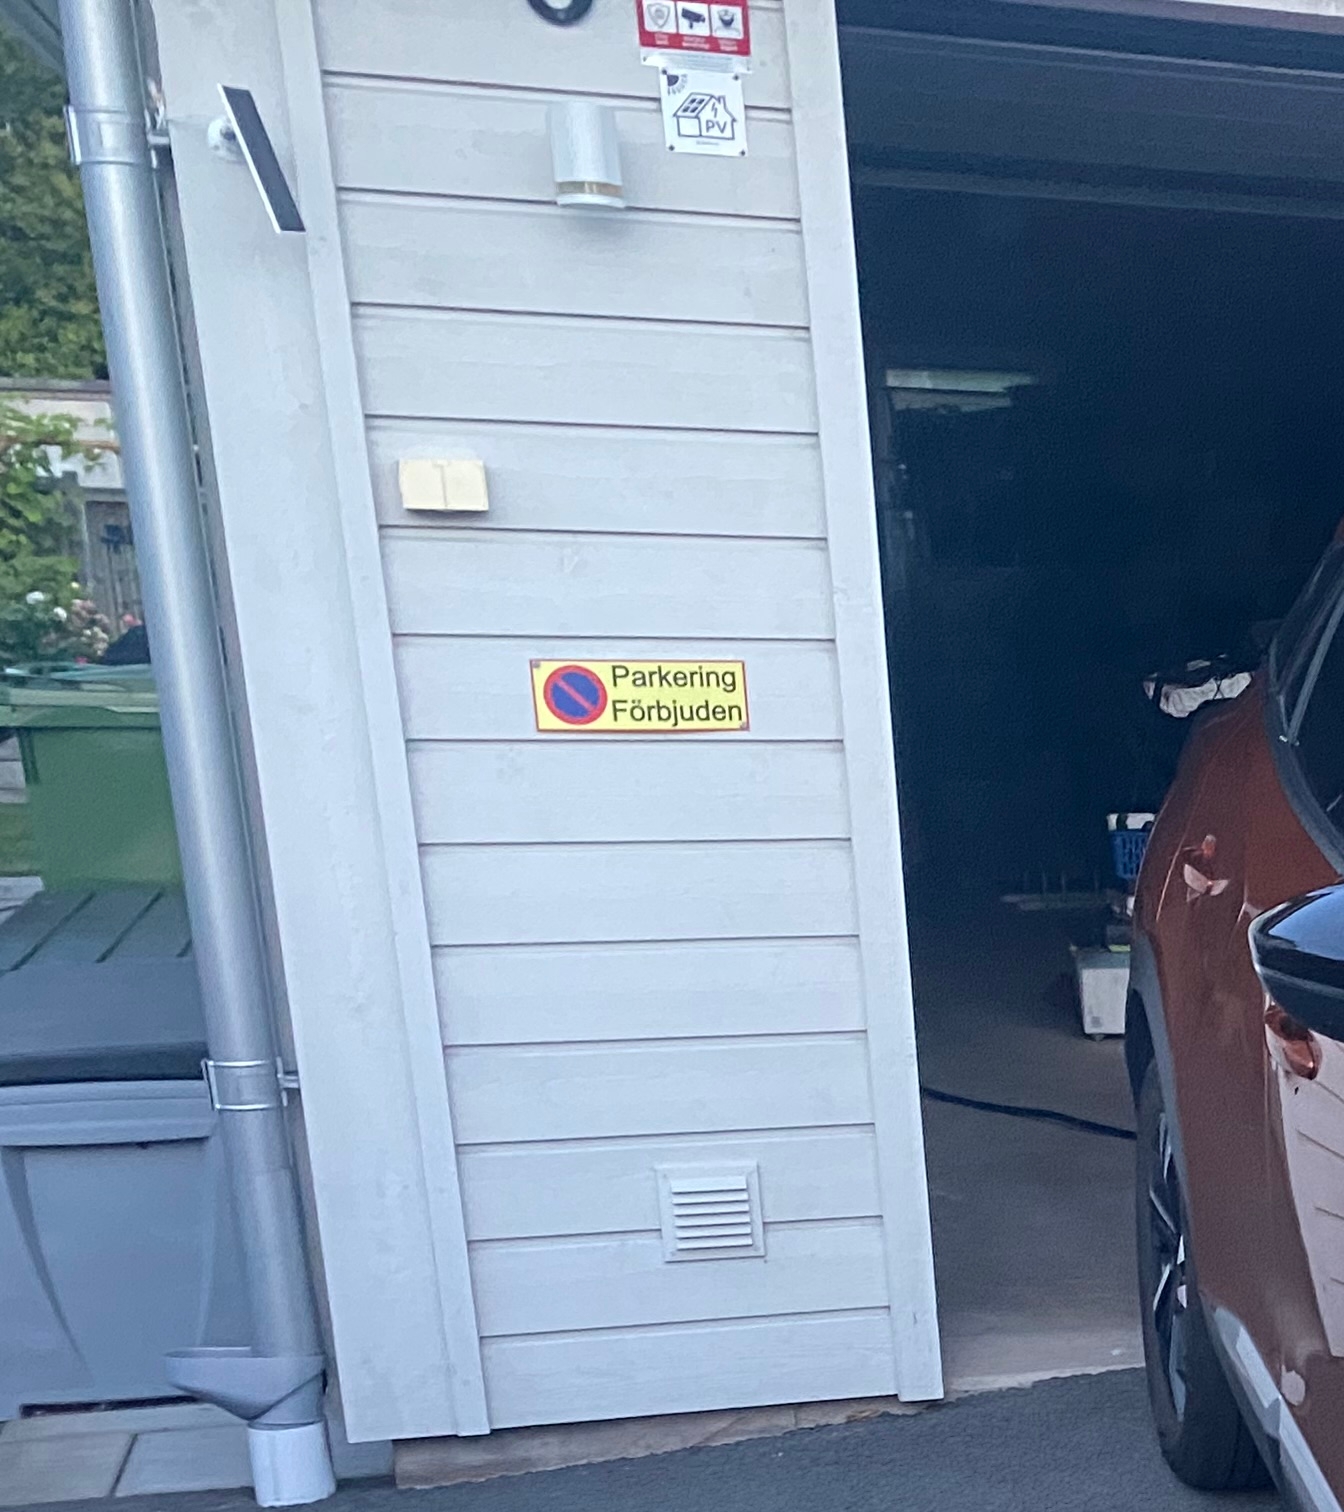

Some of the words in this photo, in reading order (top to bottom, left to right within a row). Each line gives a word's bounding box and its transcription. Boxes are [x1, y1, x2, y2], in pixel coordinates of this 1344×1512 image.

[705, 119, 728, 135] PV
[611, 665, 737, 693] Parkering
[611, 699, 742, 727] Förbjuden
